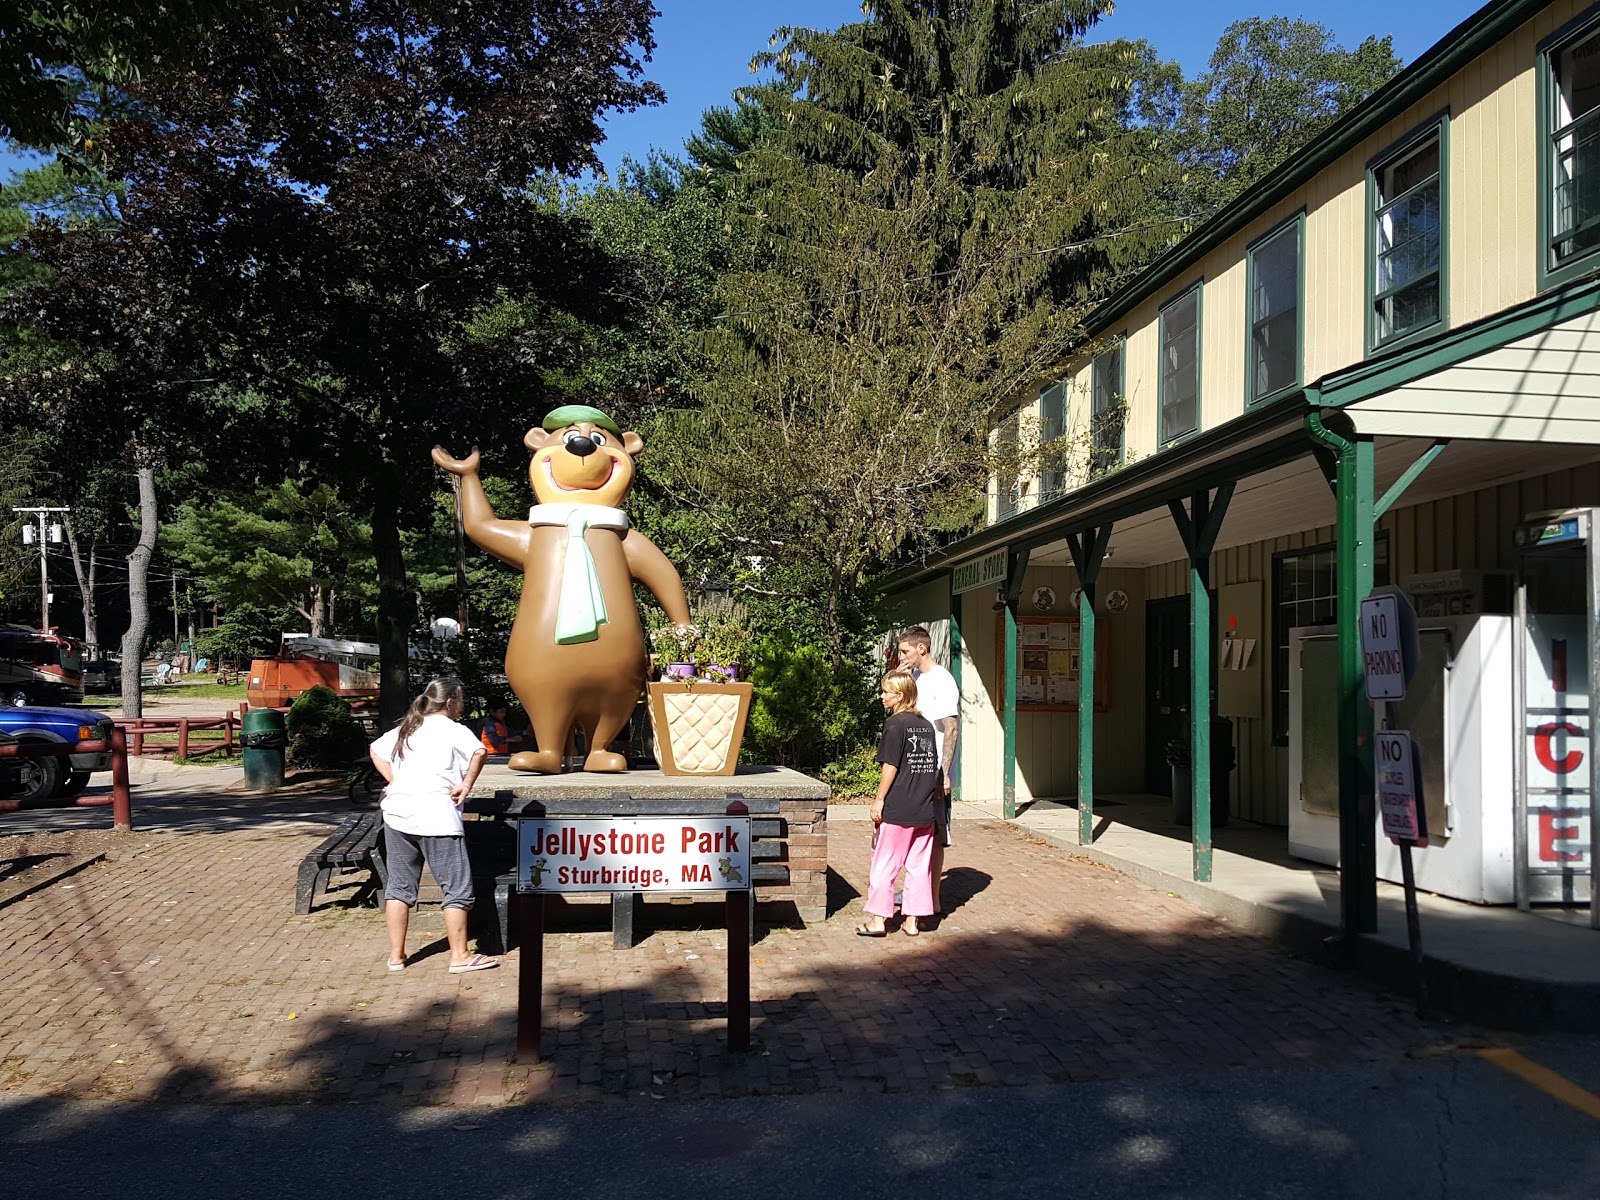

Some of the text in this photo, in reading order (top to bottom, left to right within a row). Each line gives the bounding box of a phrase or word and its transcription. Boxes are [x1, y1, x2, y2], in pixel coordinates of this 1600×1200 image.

[954, 551, 1004, 590] GENERAL STORE
[1371, 614, 1388, 640] NO
[1366, 650, 1400, 676] PARKING
[1381, 740, 1402, 762] NO
[530, 826, 739, 861] Jellystone Park
[558, 865, 712, 887] Sturbridge, MA
